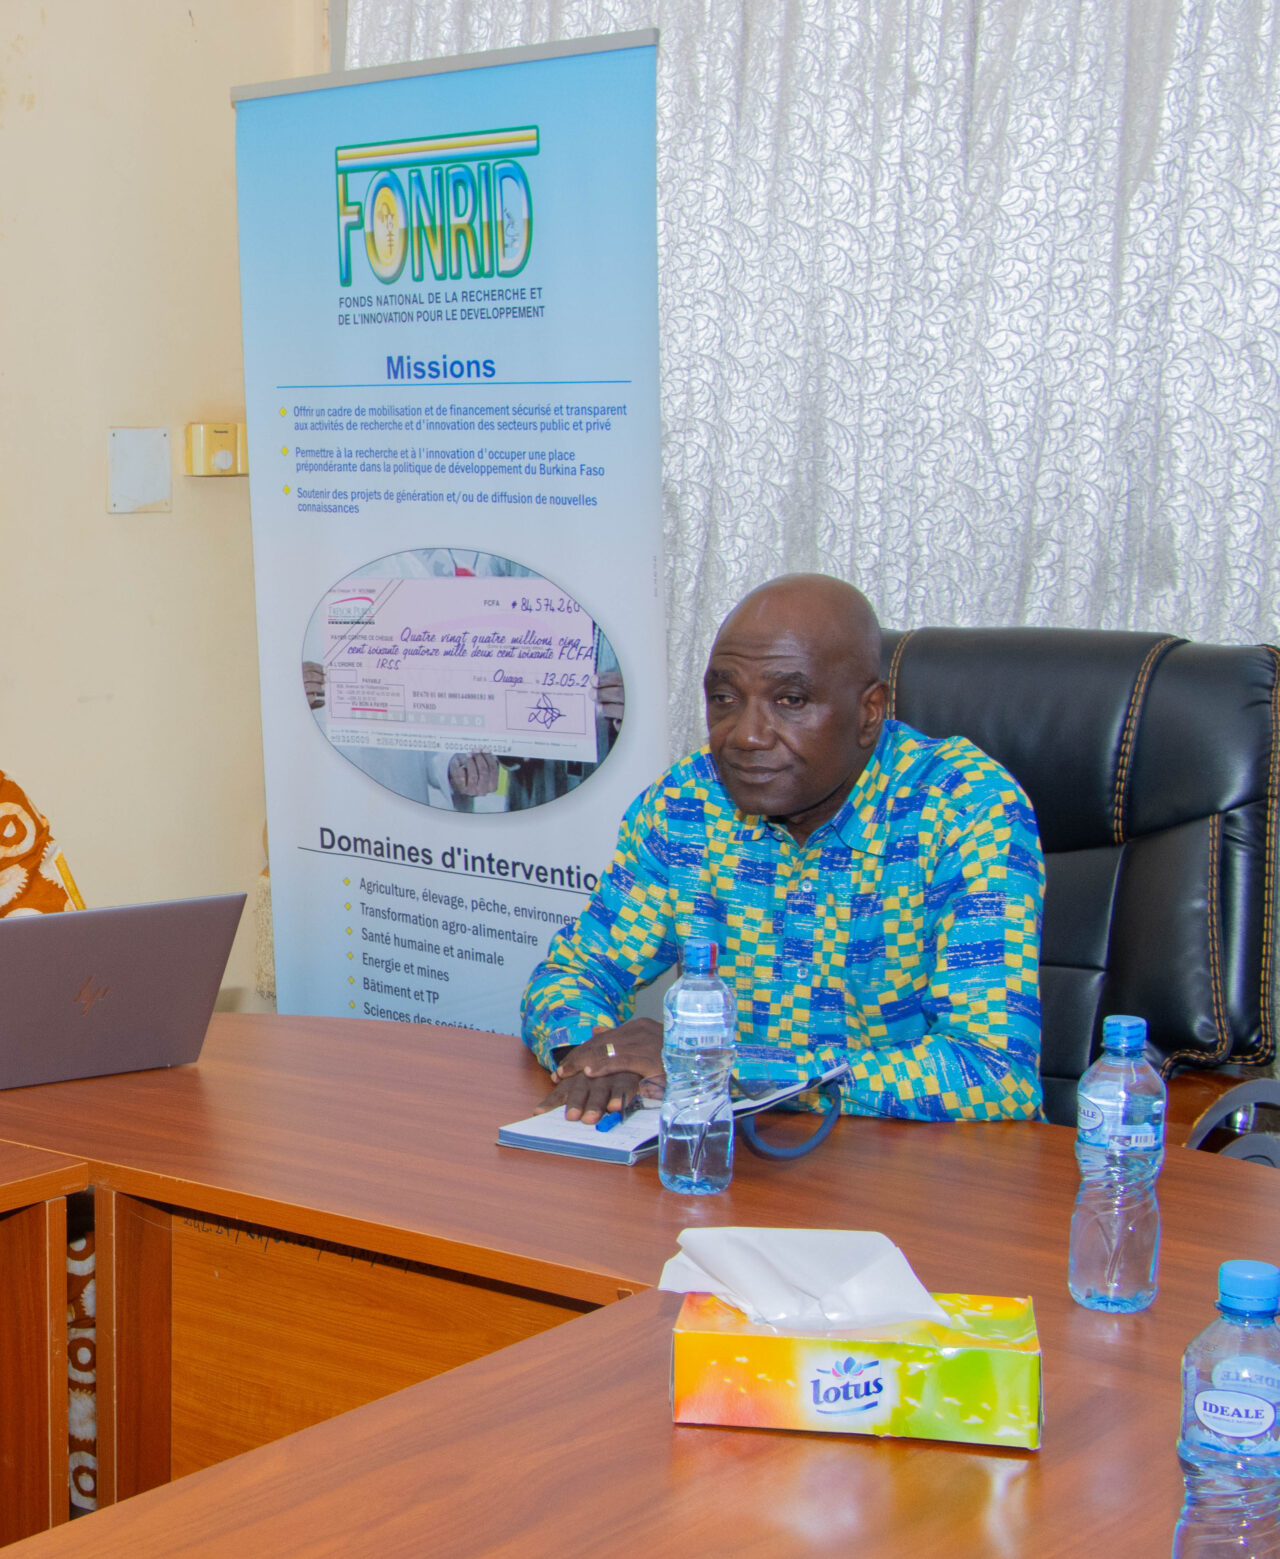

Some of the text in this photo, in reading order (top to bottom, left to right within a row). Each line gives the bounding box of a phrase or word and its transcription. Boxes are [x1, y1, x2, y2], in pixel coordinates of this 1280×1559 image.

[335, 125, 540, 287] FONRID
[338, 287, 543, 309] FONDS NATIONAL DE LA RECHERCHE ET
[338, 305, 545, 326] DE L'INNOVATION POUR LE DEVELOPPEMENT
[386, 354, 496, 380] Missions
[293, 403, 628, 418] Offrir un cadre de mobilisation et de financement sécurisé et transparent
[294, 421, 308, 431] aux
[310, 419, 344, 431] activités
[346, 419, 358, 431] de
[360, 419, 403, 431] recherche
[404, 420, 414, 431] et
[477, 419, 495, 431] des
[497, 420, 538, 431] secteurs
[539, 419, 571, 433] public
[572, 419, 583, 431] et
[585, 418, 612, 433] privé
[295, 446, 334, 459] Permettre
[336, 447, 343, 458] à
[343, 447, 353, 458] la
[355, 447, 398, 459] recherche
[400, 448, 409, 459] et
[410, 447, 417, 459] à
[528, 450, 546, 460] une
[548, 449, 576, 463] place
[295, 461, 606, 477] prépondérante dans la politique de développement du Burkina Faso
[297, 487, 330, 499] Soutenir
[332, 488, 349, 500] des
[350, 488, 382, 502] projets
[383, 489, 395, 501] de
[396, 489, 445, 504] génération
[476, 491, 489, 503] de
[491, 491, 533, 504] diffusion
[535, 492, 547, 505] de
[549, 493, 598, 507] nouvelles
[297, 502, 360, 514] connaissances
[400, 627, 436, 643] Quatre
[471, 632, 506, 648] quatre
[510, 630, 553, 646] millions
[496, 646, 517, 658] cent
[558, 645, 594, 661] FCFA
[493, 669, 524, 688] Ouaga
[320, 827, 599, 892] Domaines d'interventio
[359, 877, 420, 901] Agriculture,
[422, 887, 468, 910] élevage,
[471, 897, 511, 919] pêche,
[360, 902, 539, 947] Transformation agro-alimentaire
[361, 927, 505, 967] Santé humaine et animale
[362, 952, 450, 982] Energie et mines
[362, 977, 440, 1005] Bâtiment et TP
[363, 1001, 411, 1024] Sciences
[810, 1374, 884, 1407] lotus
[1202, 1400, 1265, 1419] IDEALE
